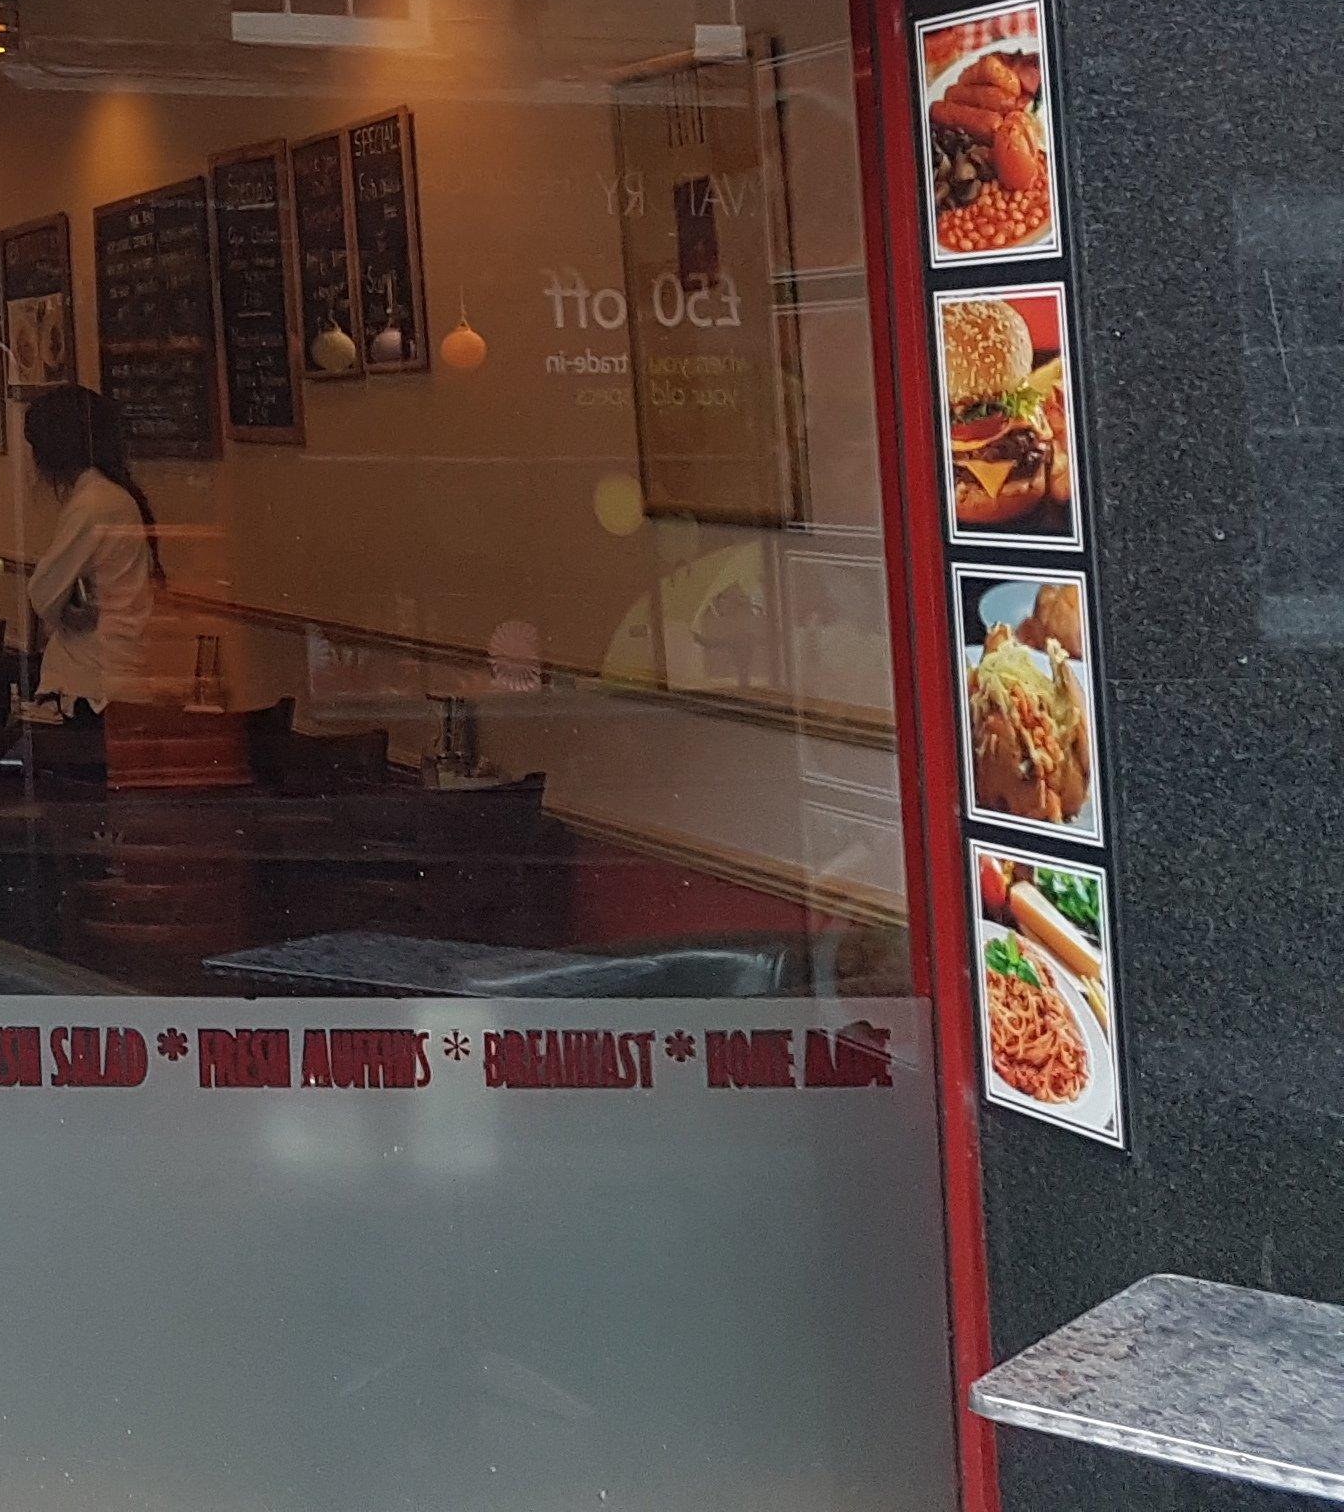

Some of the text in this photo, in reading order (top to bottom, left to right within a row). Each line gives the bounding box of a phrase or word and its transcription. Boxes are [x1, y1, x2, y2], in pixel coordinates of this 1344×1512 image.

[50, 1025, 150, 1088] SALAD
[197, 1028, 292, 1089] FRESH
[301, 1028, 432, 1089] MUFFINS
[483, 1029, 656, 1089] BREAKFAST
[705, 1028, 797, 1089] HOME
